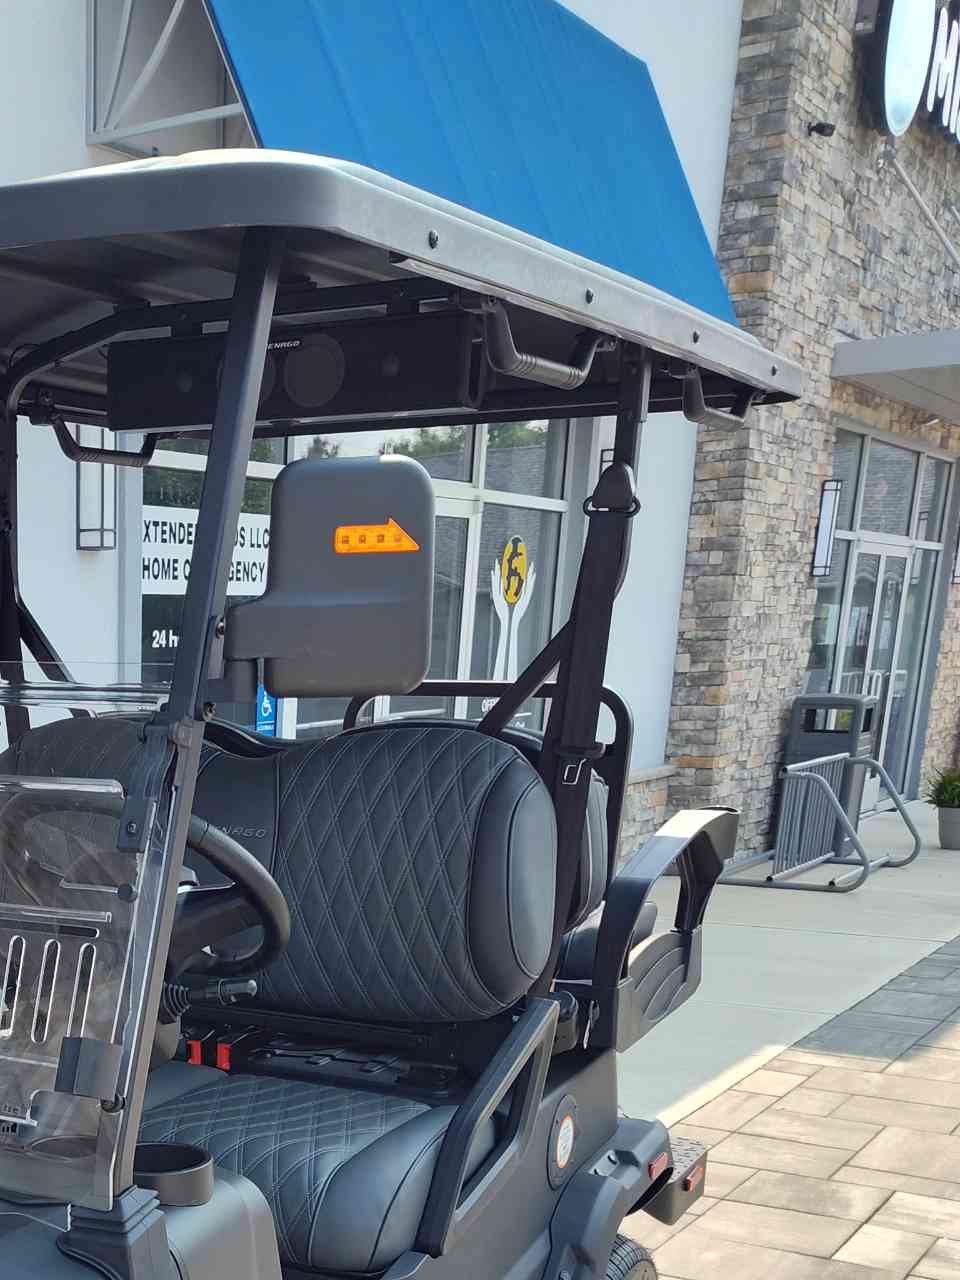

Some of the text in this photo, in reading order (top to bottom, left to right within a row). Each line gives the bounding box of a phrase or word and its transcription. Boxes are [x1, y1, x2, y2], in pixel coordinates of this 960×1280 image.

[268, 340, 301, 350] ENAGO
[143, 519, 198, 545] XTENDE
[142, 557, 179, 581] HOME
[228, 561, 265, 582] GENCY
[152, 629, 167, 649] 24
